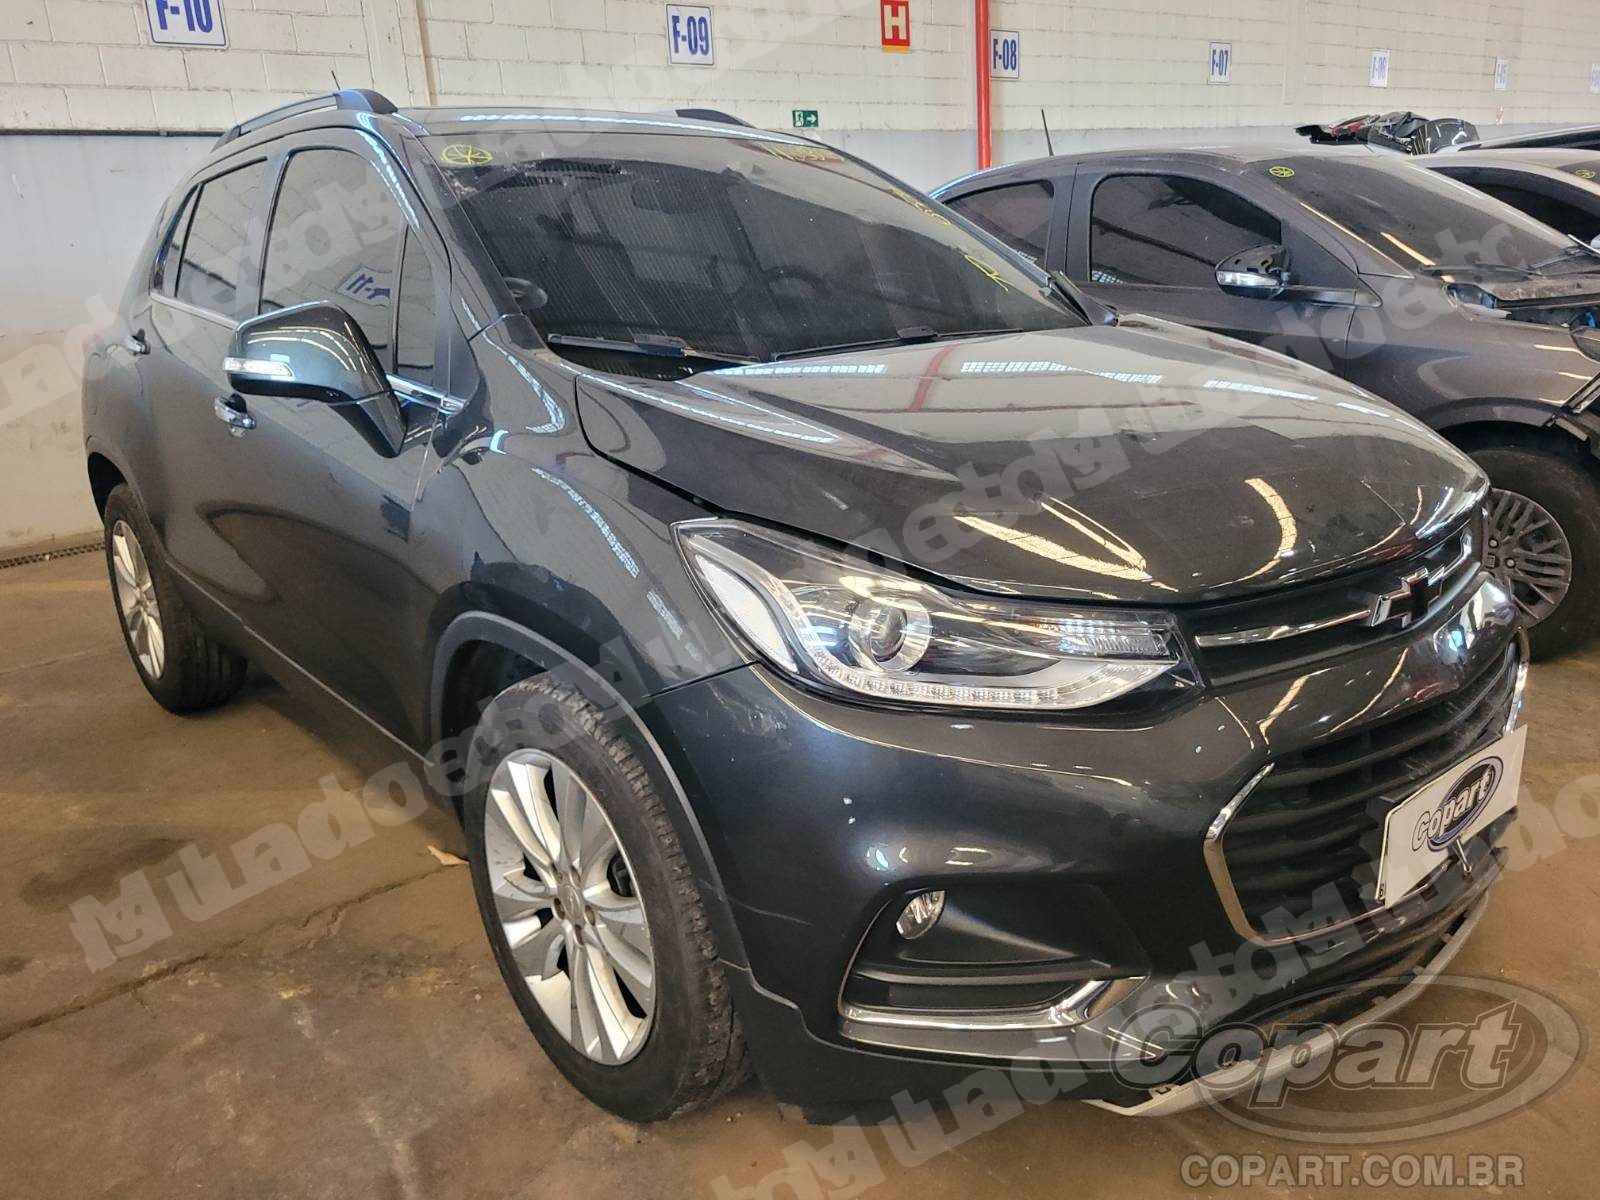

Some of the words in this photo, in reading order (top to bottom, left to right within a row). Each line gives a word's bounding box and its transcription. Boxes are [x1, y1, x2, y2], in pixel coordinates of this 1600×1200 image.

[155, 0, 213, 33] F-10
[883, 4, 907, 40] H
[672, 15, 709, 55] F-09
[993, 38, 1017, 70] F-08
[1211, 49, 1229, 76] F-07
[1411, 763, 1494, 852] Copart
